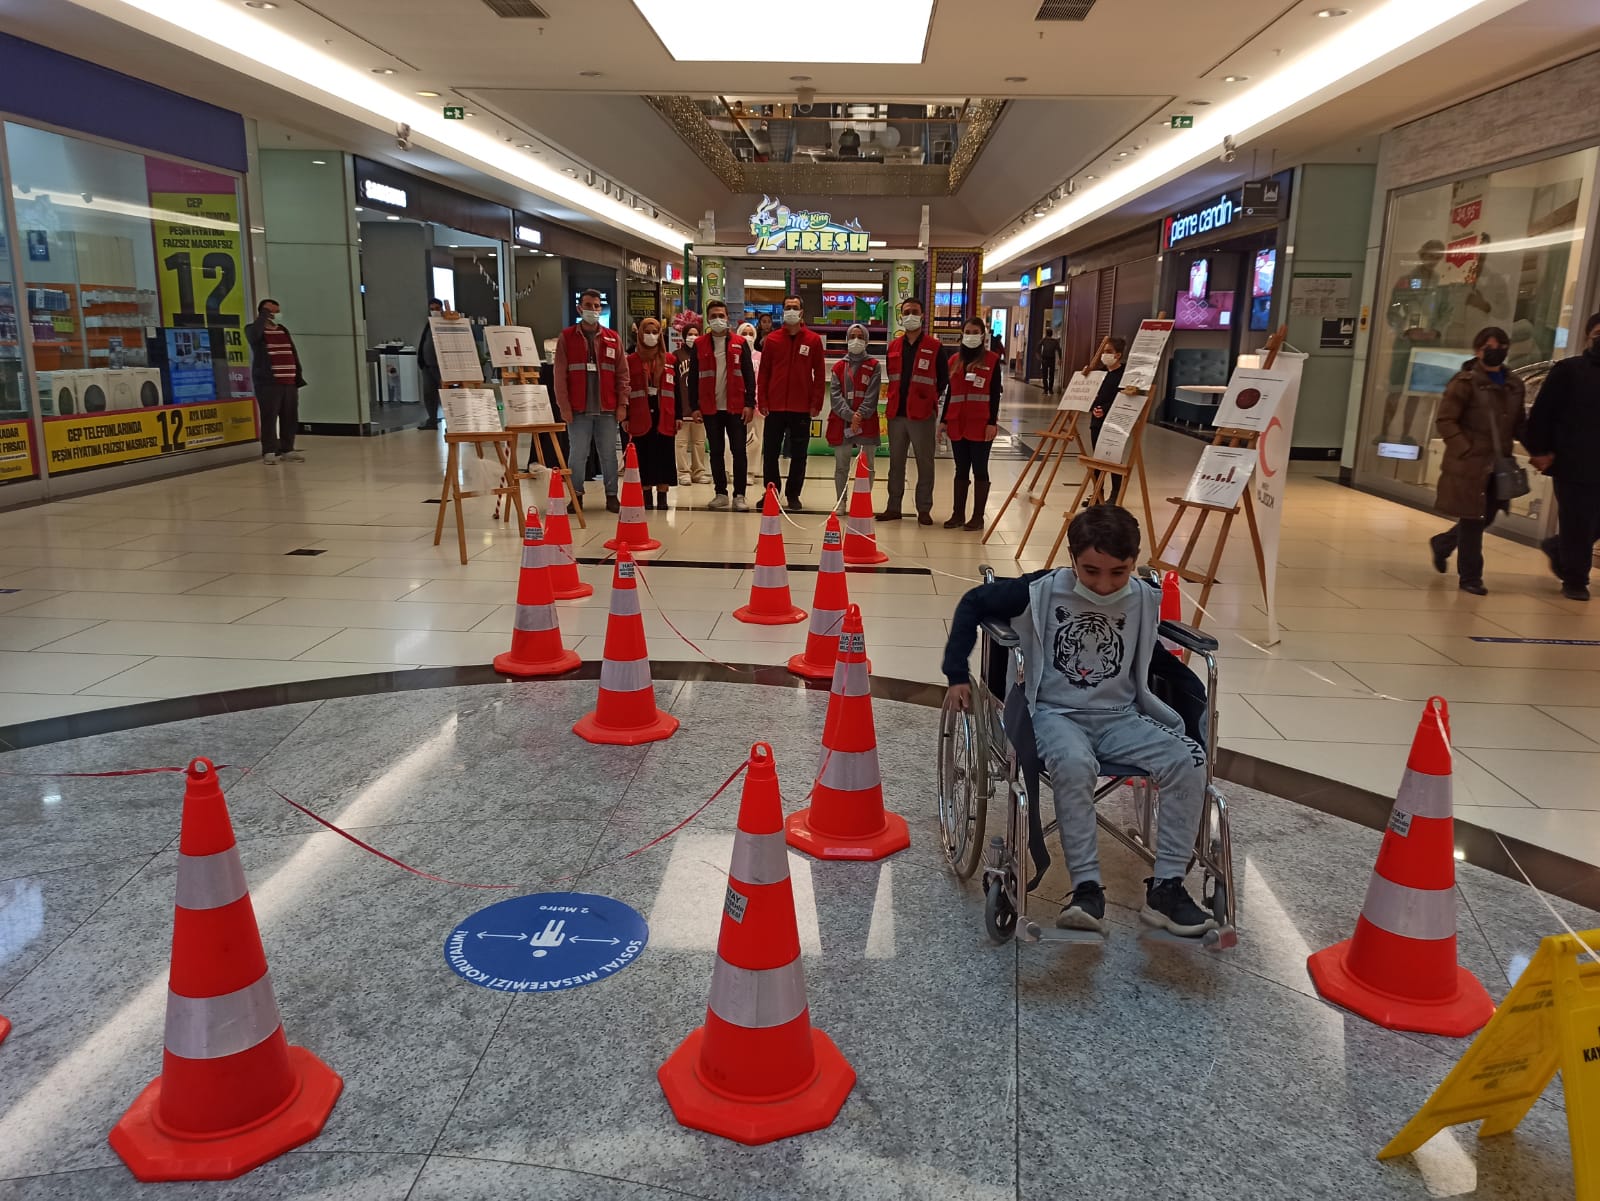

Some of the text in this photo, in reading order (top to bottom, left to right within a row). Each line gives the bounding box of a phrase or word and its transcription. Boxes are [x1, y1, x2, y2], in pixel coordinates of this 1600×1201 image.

[1198, 194, 1232, 233] cardin
[785, 232, 869, 252] FRESH
[164, 252, 240, 328] 12
[83, 421, 142, 440] TELEFONLARINDA
[157, 410, 186, 454] 12
[539, 905, 578, 914] Metre
[449, 930, 642, 992] SOSYAL MESAFEMİZİ KORUYALIM!
